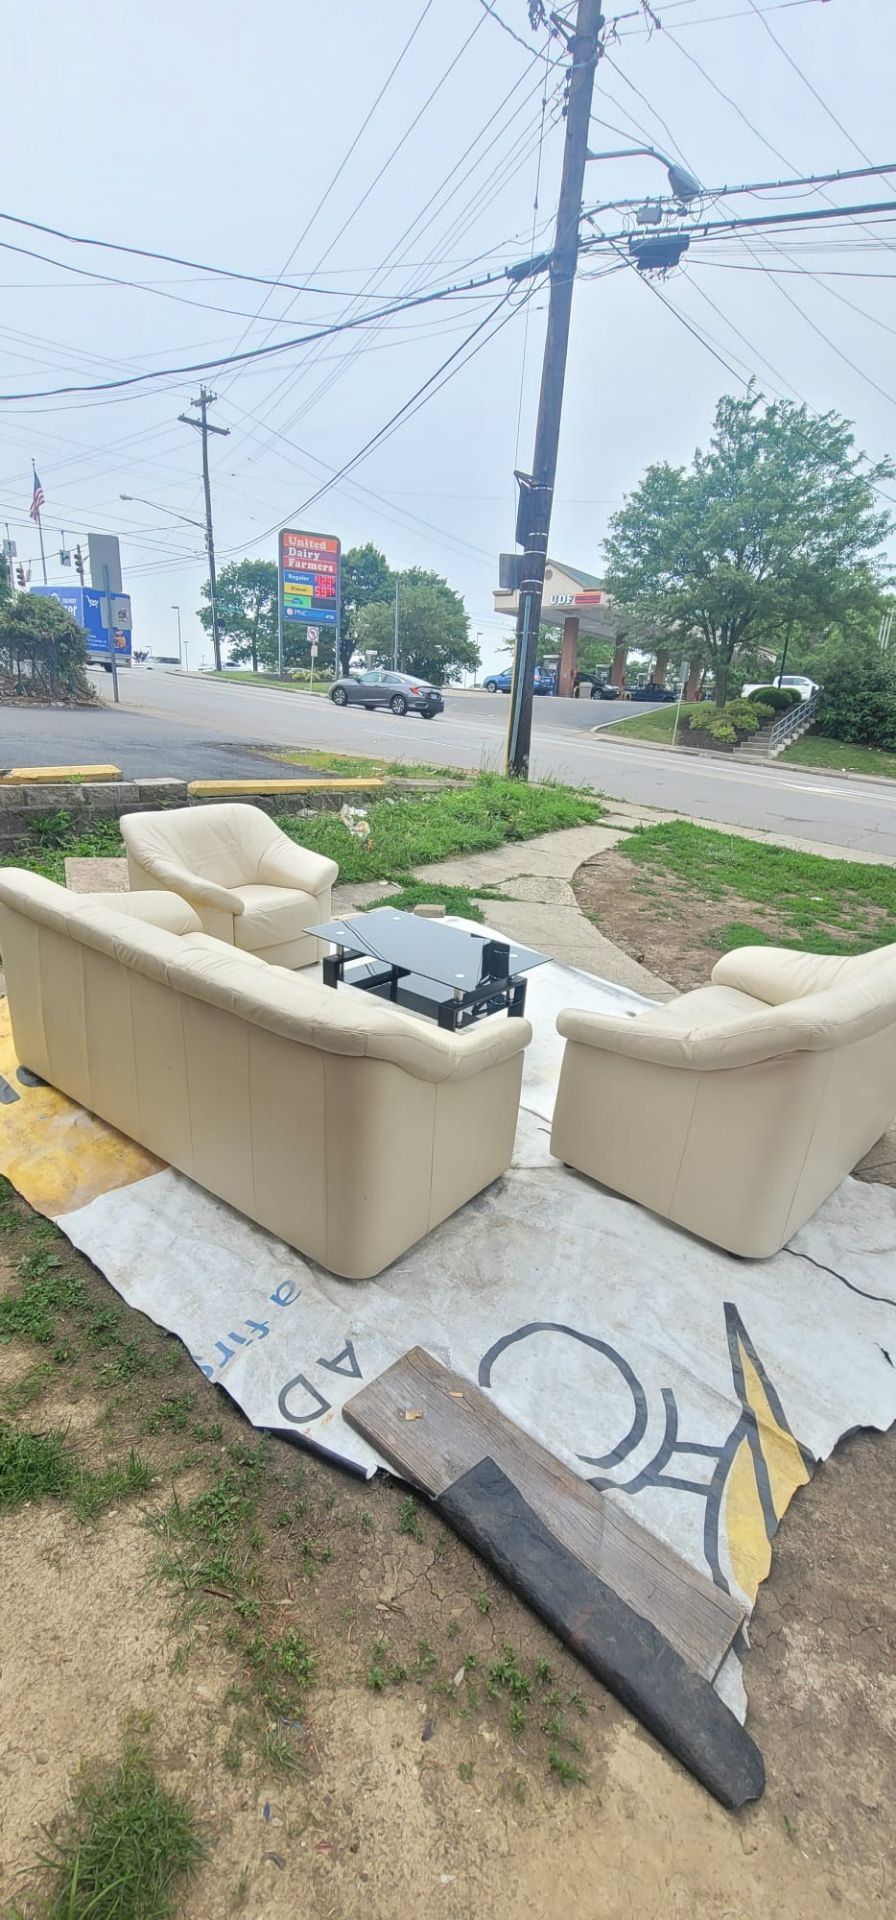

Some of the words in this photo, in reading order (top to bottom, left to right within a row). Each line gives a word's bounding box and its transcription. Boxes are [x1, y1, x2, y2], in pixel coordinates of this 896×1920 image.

[288, 536, 327, 550] United
[288, 547, 320, 561] Dairy
[288, 558, 334, 572] Farmers
[551, 594, 574, 604] UDF
[270, 1279, 303, 1307] a
